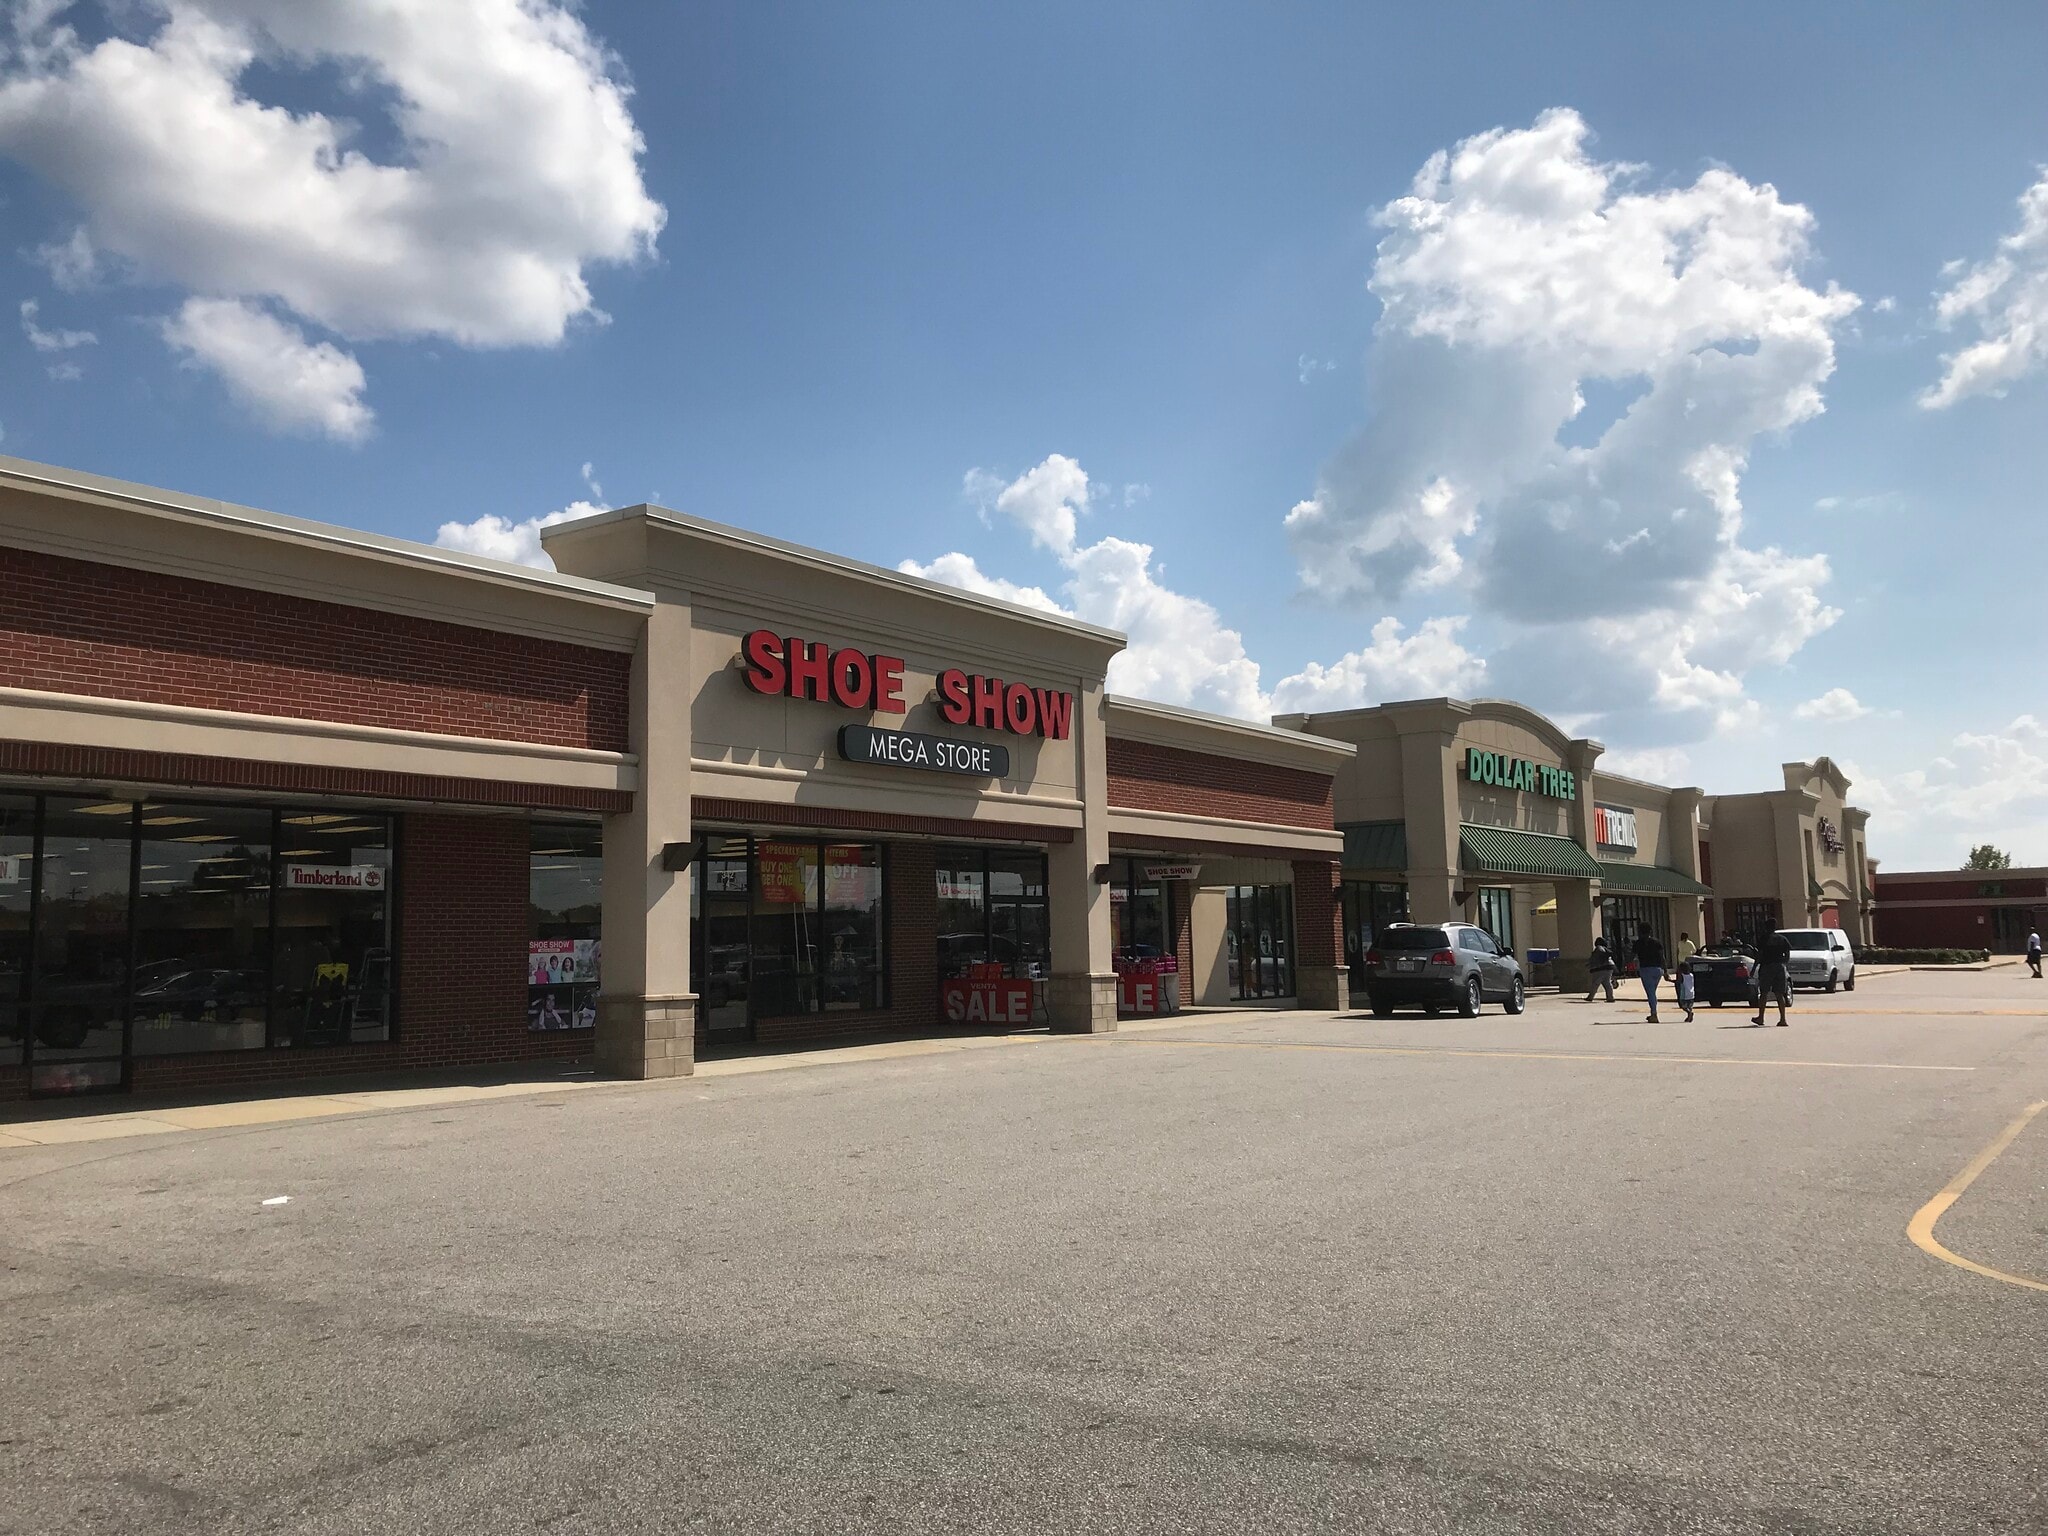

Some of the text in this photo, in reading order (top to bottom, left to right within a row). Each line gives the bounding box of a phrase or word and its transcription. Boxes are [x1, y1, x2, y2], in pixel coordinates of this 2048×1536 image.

[741, 629, 1073, 740] SHOE SHOW
[869, 733, 991, 772] MEGA STORE
[1465, 747, 1576, 801] DOLLAR TREE
[766, 845, 799, 856] SPECIALLY
[761, 861, 793, 873] BUY ONE
[833, 864, 858, 879] OFF
[292, 868, 362, 886] Timberland
[777, 873, 793, 886] ONE
[529, 941, 548, 949] SHOE
[947, 990, 1029, 1022] SALE
[1118, 983, 1154, 1012] LE
